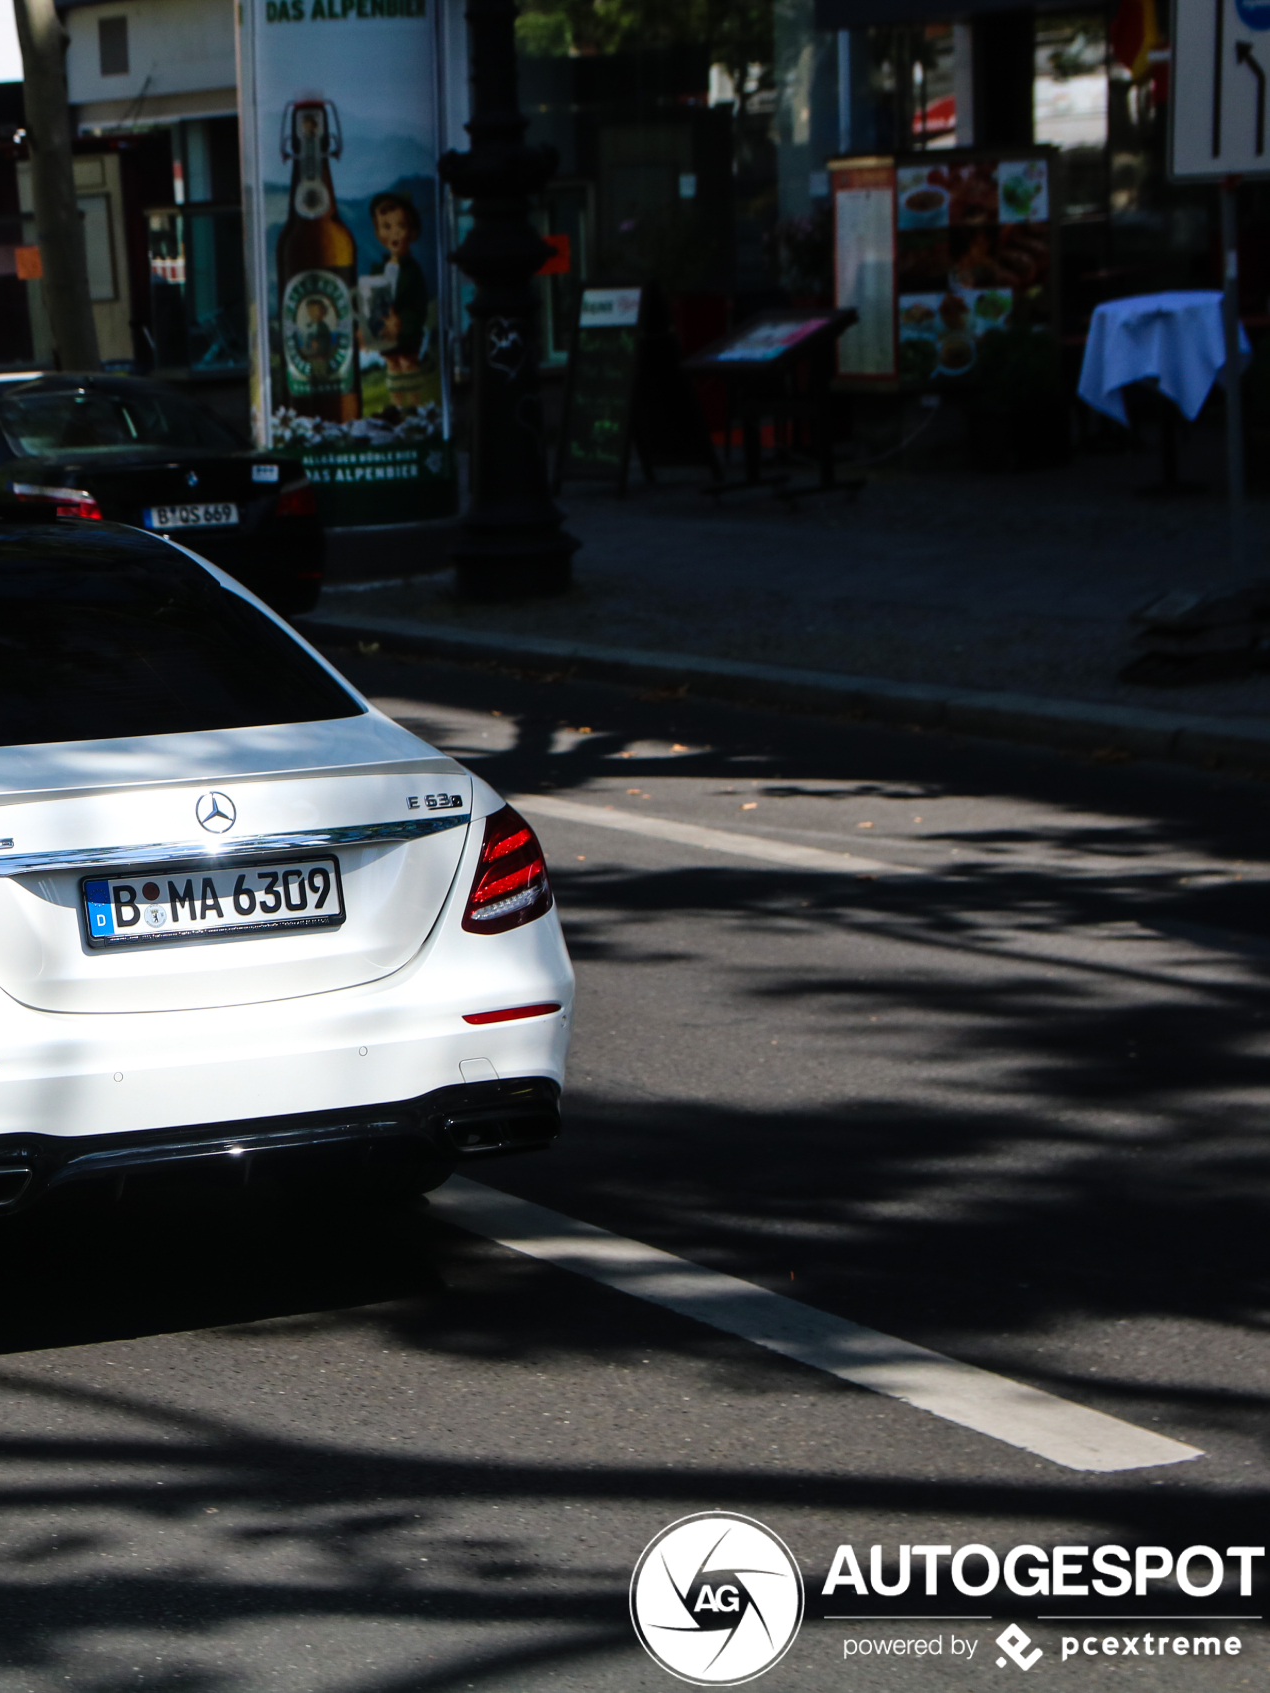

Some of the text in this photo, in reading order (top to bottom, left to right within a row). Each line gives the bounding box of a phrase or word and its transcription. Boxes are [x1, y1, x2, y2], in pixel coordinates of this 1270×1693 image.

[266, 0, 305, 23] DAS
[334, 464, 419, 483] ALPENBIER
[157, 507, 169, 525] B
[203, 503, 231, 523] 669
[406, 796, 421, 810] E
[112, 867, 331, 928] B MA 6309
[96, 914, 107, 927] D
